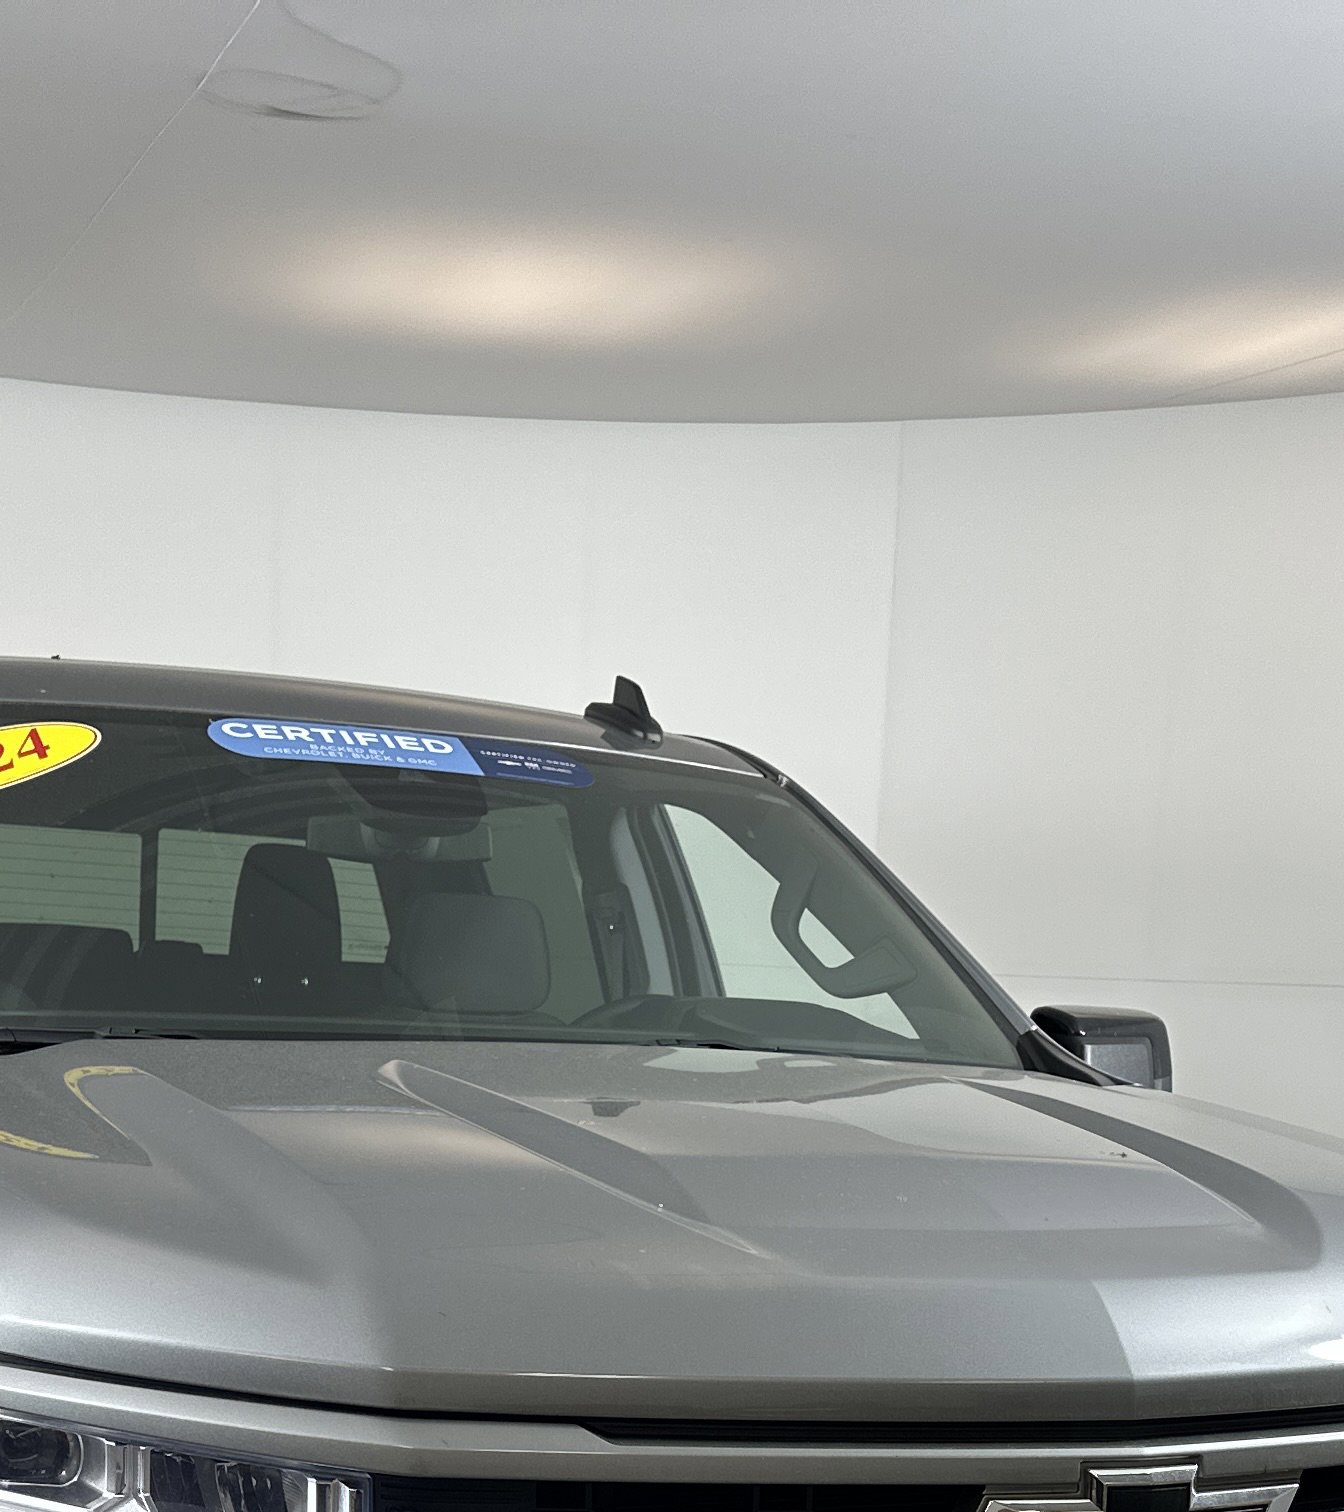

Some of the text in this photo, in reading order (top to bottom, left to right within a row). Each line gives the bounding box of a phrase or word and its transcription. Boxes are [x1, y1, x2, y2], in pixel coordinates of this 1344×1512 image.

[221, 722, 454, 754] CERTIFIED
[309, 743, 365, 754] BACKED
[351, 752, 393, 762] BUICK
[407, 757, 438, 767] GMC
